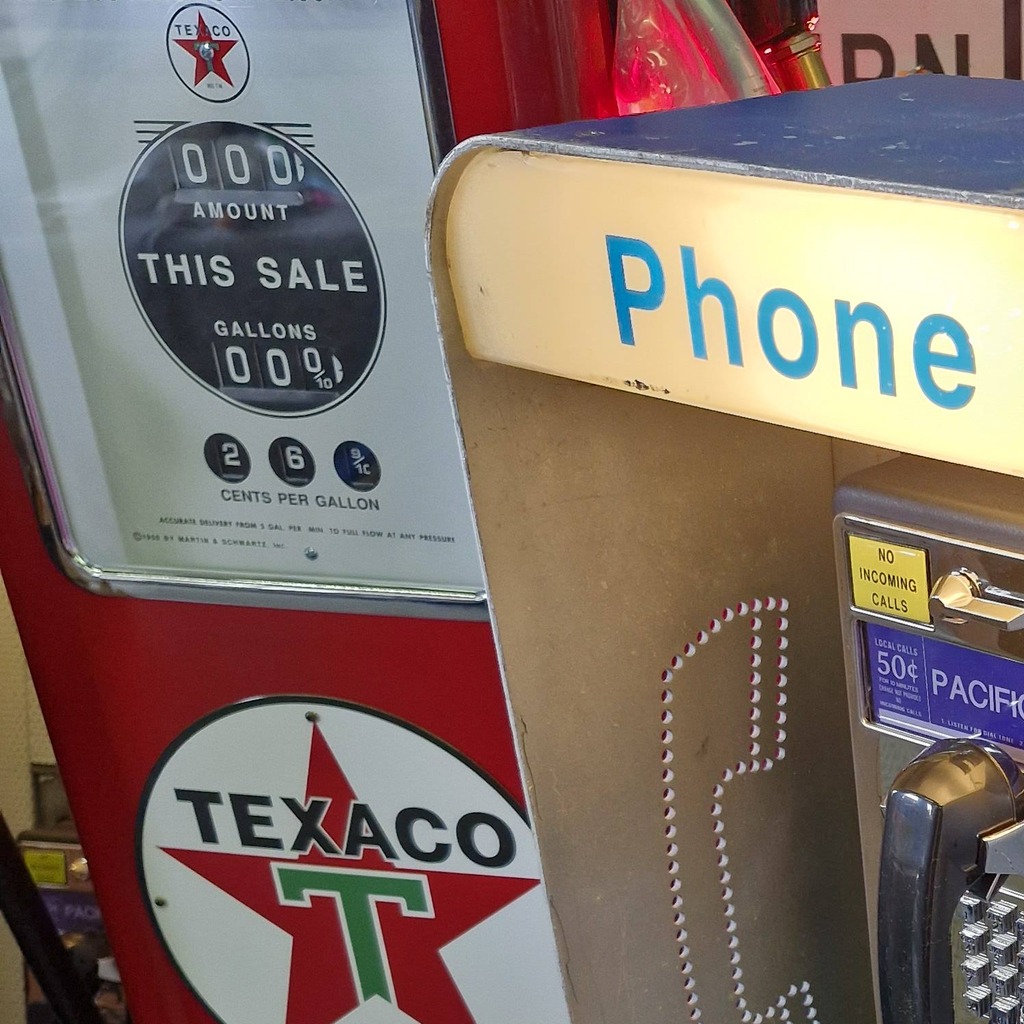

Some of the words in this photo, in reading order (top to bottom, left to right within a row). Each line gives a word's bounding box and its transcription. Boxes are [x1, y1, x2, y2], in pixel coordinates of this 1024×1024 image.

[174, 24, 231, 37] TEXACO
[193, 202, 288, 220] AMOUNT
[137, 253, 235, 287] THIS
[256, 256, 368, 293] SALE
[214, 320, 317, 341] GALLONS
[605, 234, 977, 410] Phone
[222, 443, 242, 466] 2
[285, 446, 305, 470] 6
[221, 489, 272, 504] CENTS
[278, 493, 309, 506] PER
[316, 495, 380, 511] GALLON
[362, 530, 383, 538] FLOW
[400, 533, 415, 541] ANY
[419, 535, 456, 543] PRESSURE
[878, 548, 894, 564] NO
[860, 567, 917, 593] INCOMING
[872, 593, 908, 613] CALLS
[875, 638, 896, 651] LOCAL
[897, 643, 918, 656] CALLS
[877, 651, 919, 684] 50¢
[948, 720, 968, 731] LISTEN
[983, 730, 997, 739] DIAL
[174, 788, 517, 868] TEXACO
